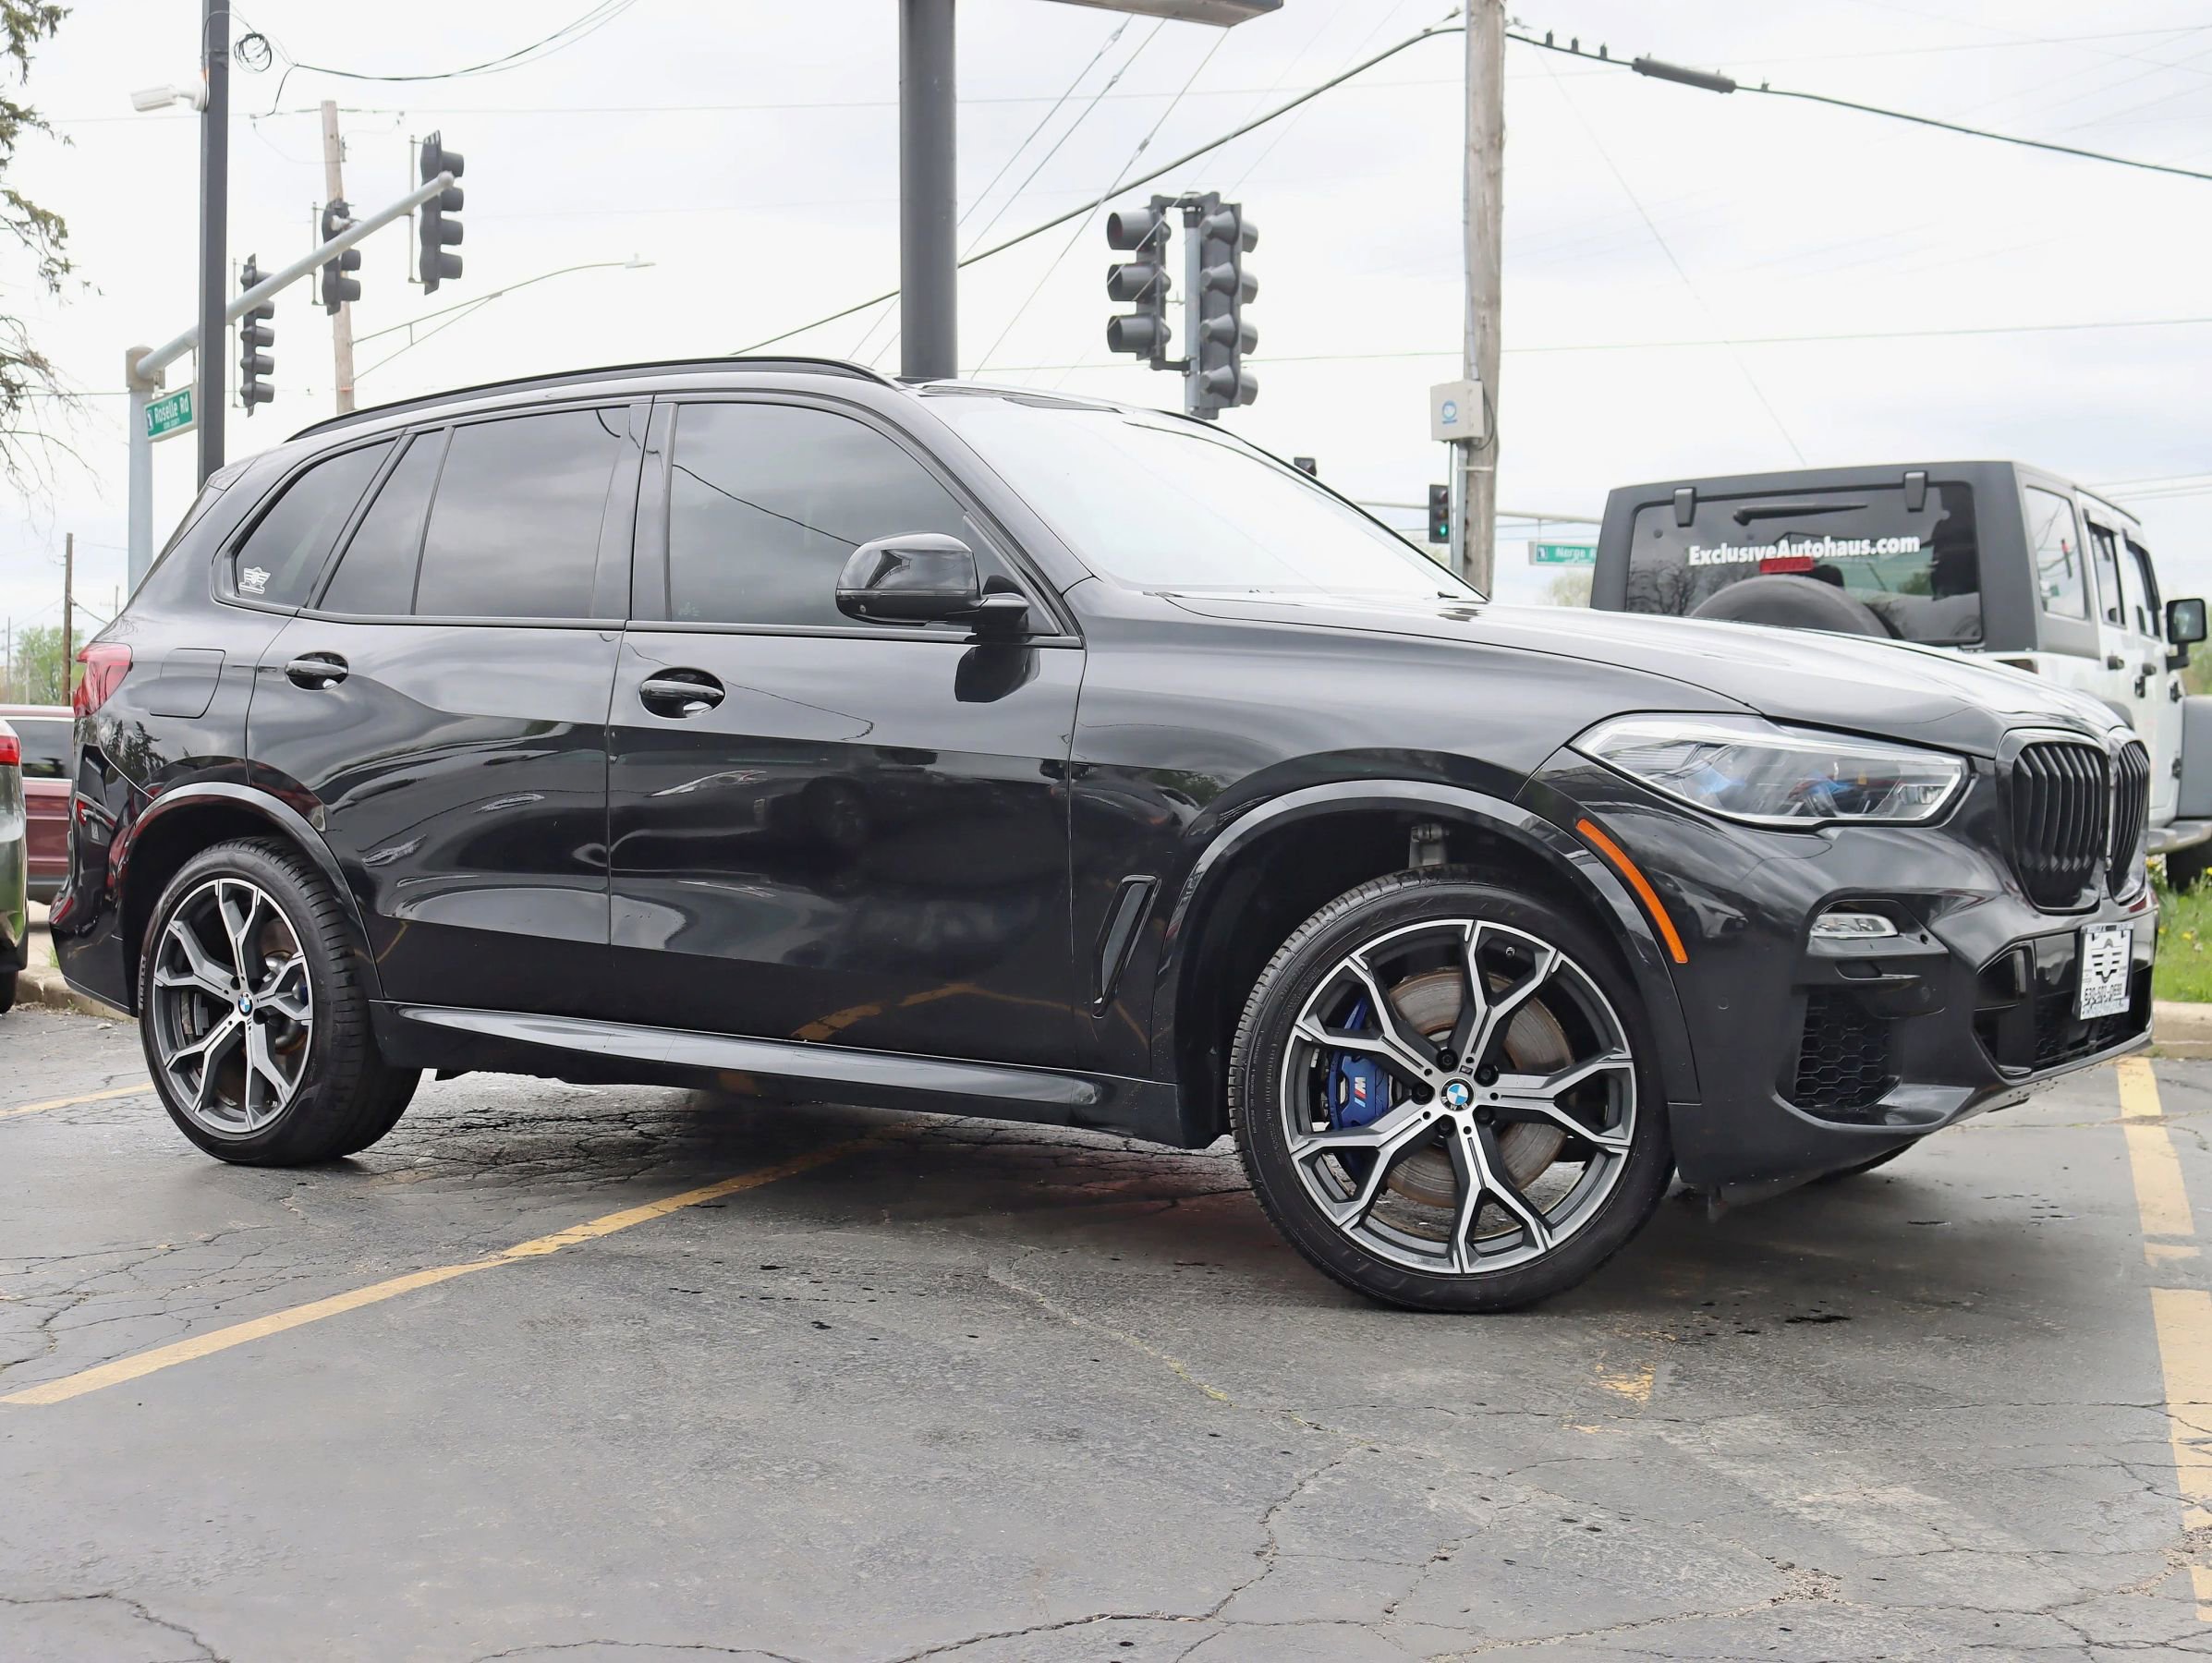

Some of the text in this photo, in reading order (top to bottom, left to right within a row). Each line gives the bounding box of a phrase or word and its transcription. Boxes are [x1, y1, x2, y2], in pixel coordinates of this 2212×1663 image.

[154, 394, 189, 423] Roselle Rd
[1689, 536, 1920, 565] ExclusiveAutohaus.com
